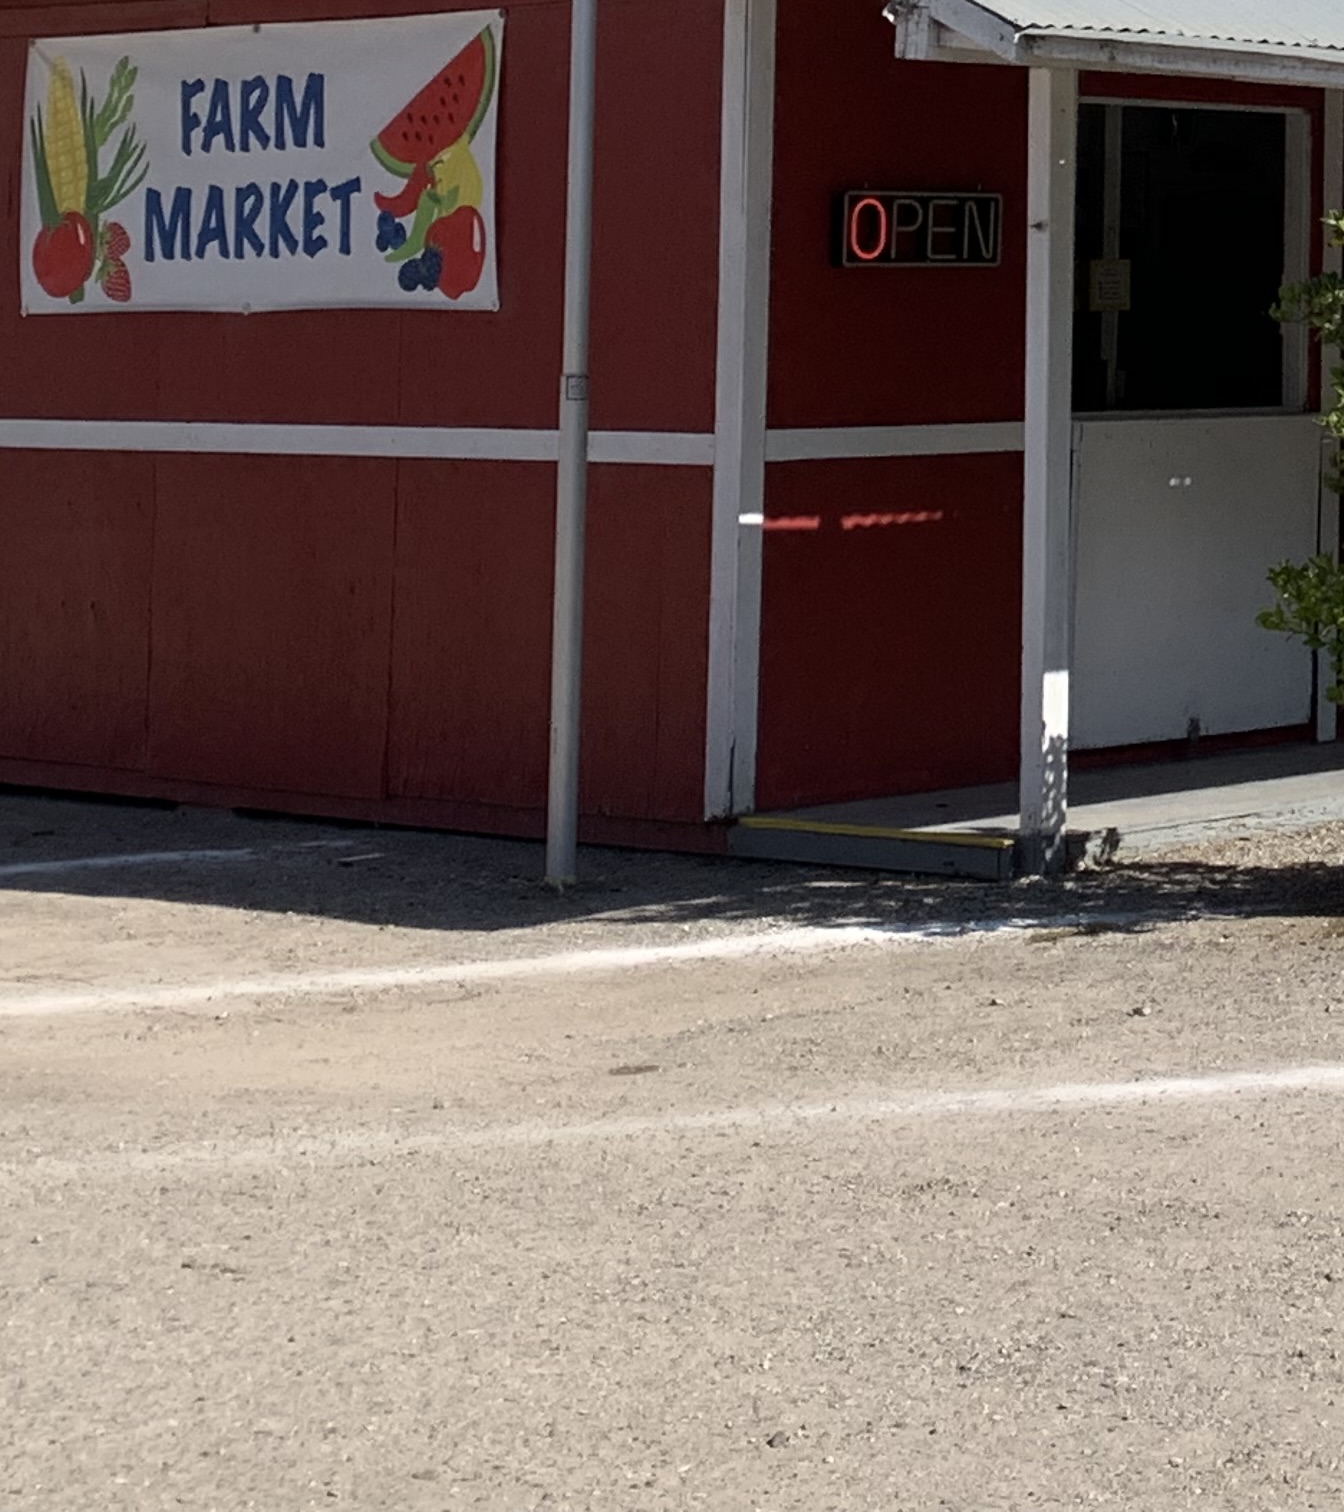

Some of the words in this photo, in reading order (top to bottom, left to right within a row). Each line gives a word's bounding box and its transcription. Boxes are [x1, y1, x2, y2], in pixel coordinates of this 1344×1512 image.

[181, 72, 326, 156] FARM
[144, 176, 362, 263] MARKET
[851, 198, 996, 260] OPEN
